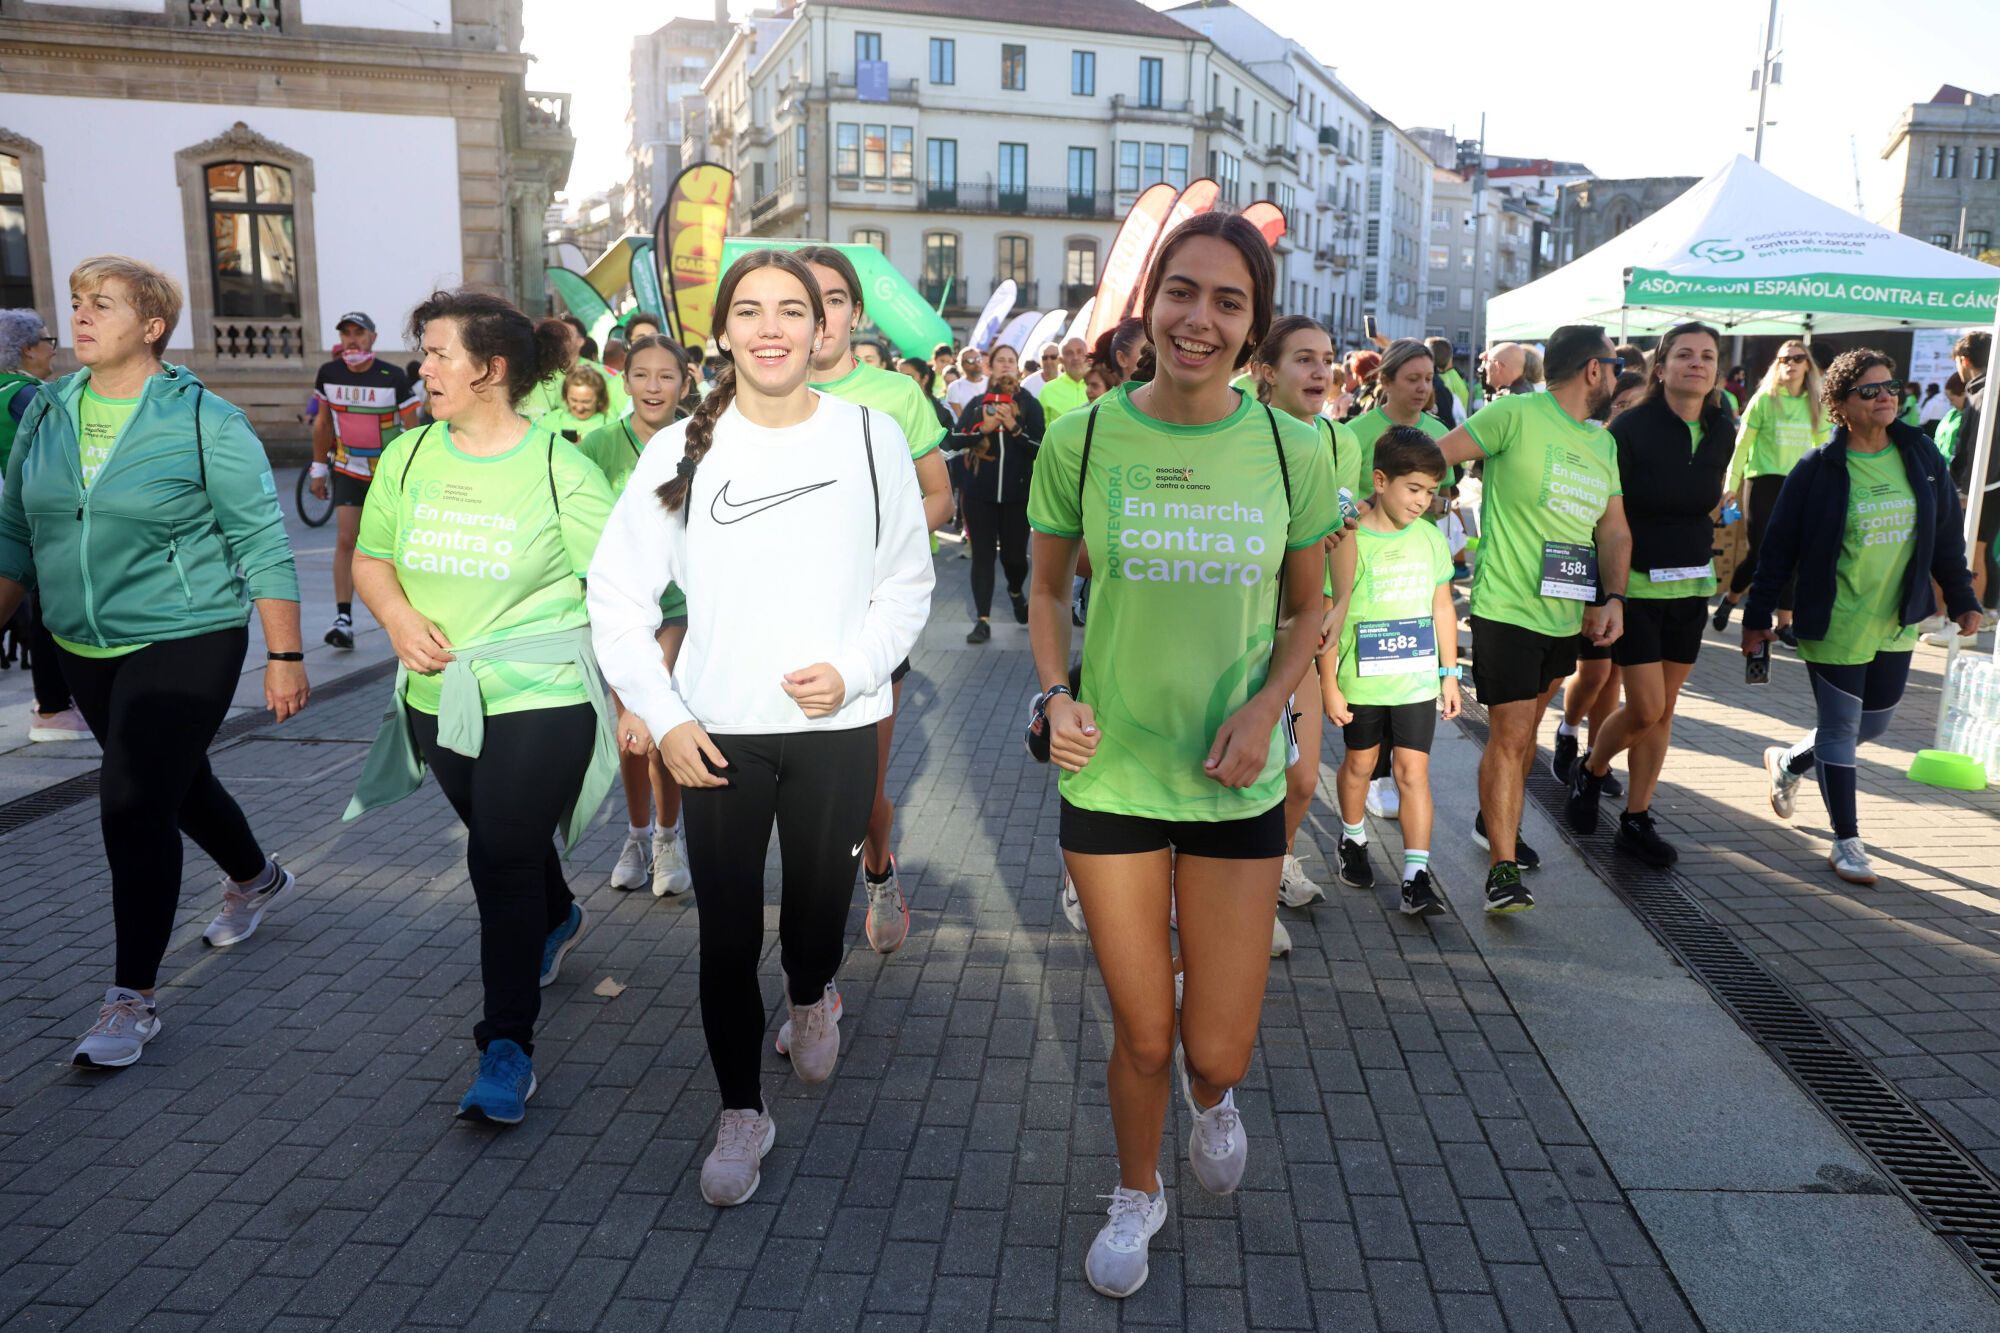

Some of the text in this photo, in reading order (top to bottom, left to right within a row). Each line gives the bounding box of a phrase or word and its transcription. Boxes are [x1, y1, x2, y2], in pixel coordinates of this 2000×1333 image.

[1752, 239, 1799, 250] contra
[1754, 277, 1846, 299] ESPAÑOLA
[1850, 285, 1924, 305] CONTRA
[1927, 291, 1949, 307] EL
[336, 386, 375, 402] ALOIA
[1552, 463, 1569, 478] En
[1550, 481, 1598, 505] contra
[414, 503, 518, 532] En marcha
[1124, 497, 1264, 524] En marcha
[1857, 501, 1877, 513] En
[1107, 464, 1122, 579] PONTEVEDRA
[408, 527, 513, 557] contra o
[1120, 526, 1265, 556] contra o
[403, 550, 511, 581] cancro
[1123, 557, 1263, 586] cancro
[1560, 561, 1587, 576] 1581
[1378, 635, 1418, 653] 1582
